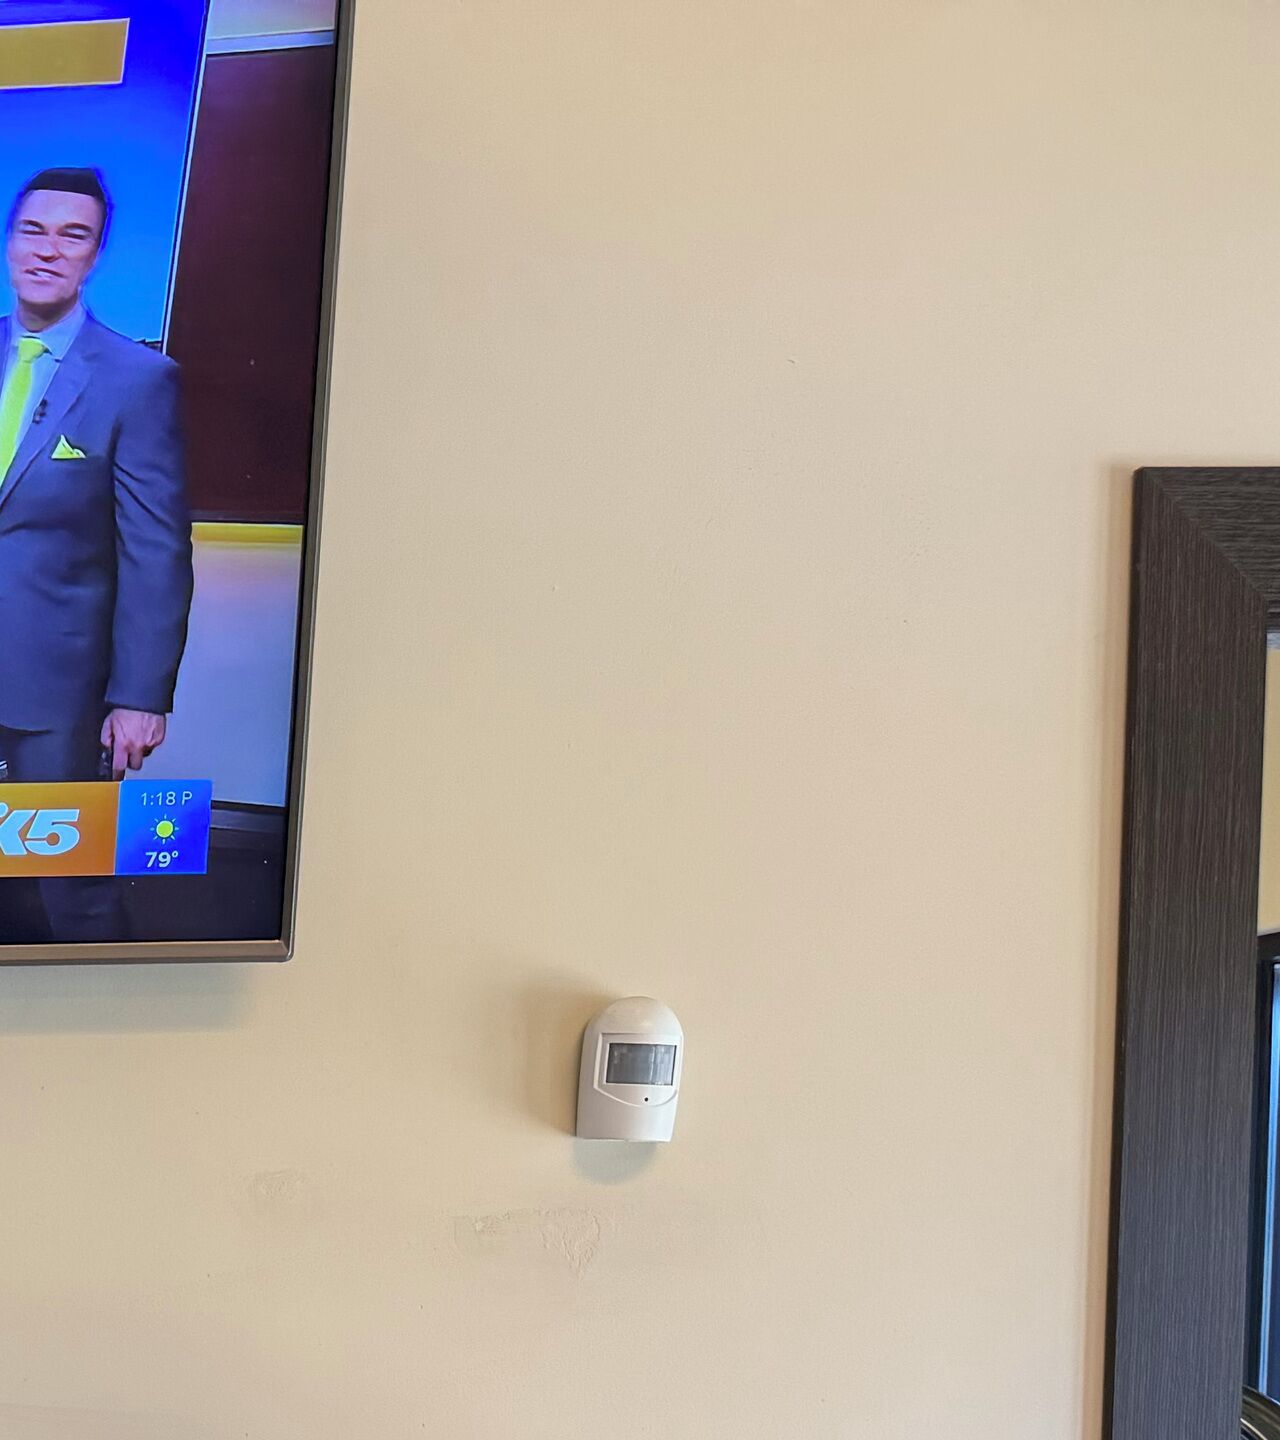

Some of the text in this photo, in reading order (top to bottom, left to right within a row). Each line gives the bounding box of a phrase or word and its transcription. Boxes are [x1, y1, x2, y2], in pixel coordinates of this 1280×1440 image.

[141, 790, 193, 806] 1:18 P
[145, 850, 179, 868] 79°
